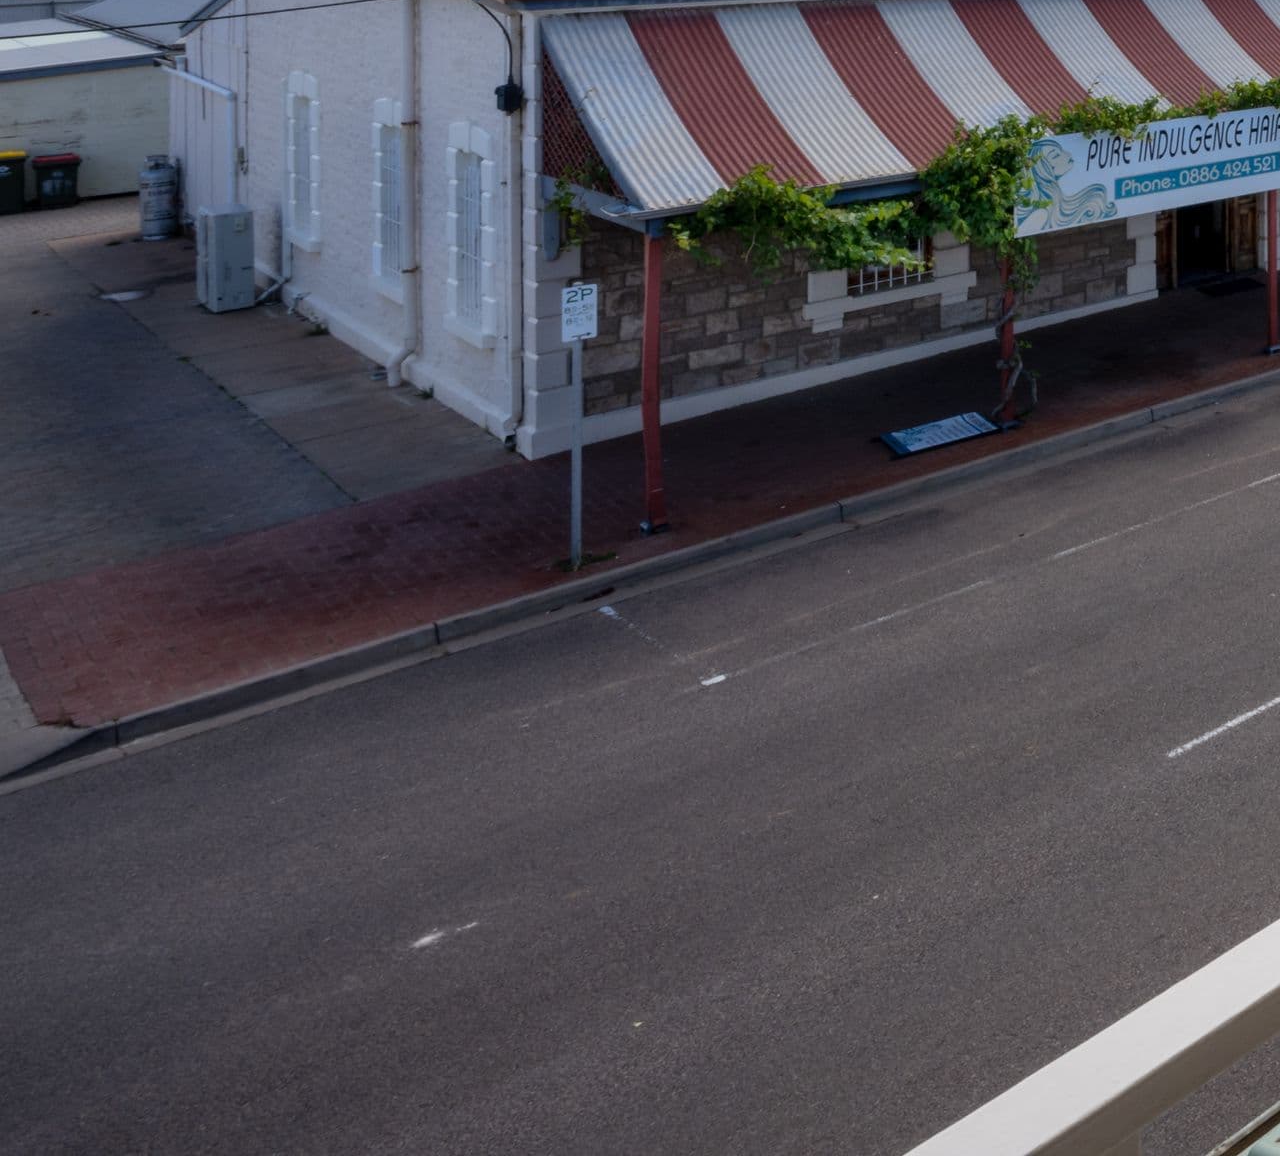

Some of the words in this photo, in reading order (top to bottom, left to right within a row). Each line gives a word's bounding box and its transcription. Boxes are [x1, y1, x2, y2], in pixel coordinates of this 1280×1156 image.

[1086, 135, 1134, 171] PURE
[1138, 118, 1244, 162] INDULGENCE
[1121, 175, 1176, 196] Phone:
[1179, 165, 1219, 186] 0886
[1222, 160, 1251, 178] 424
[1253, 155, 1276, 173] 521
[566, 287, 593, 304] 2P
